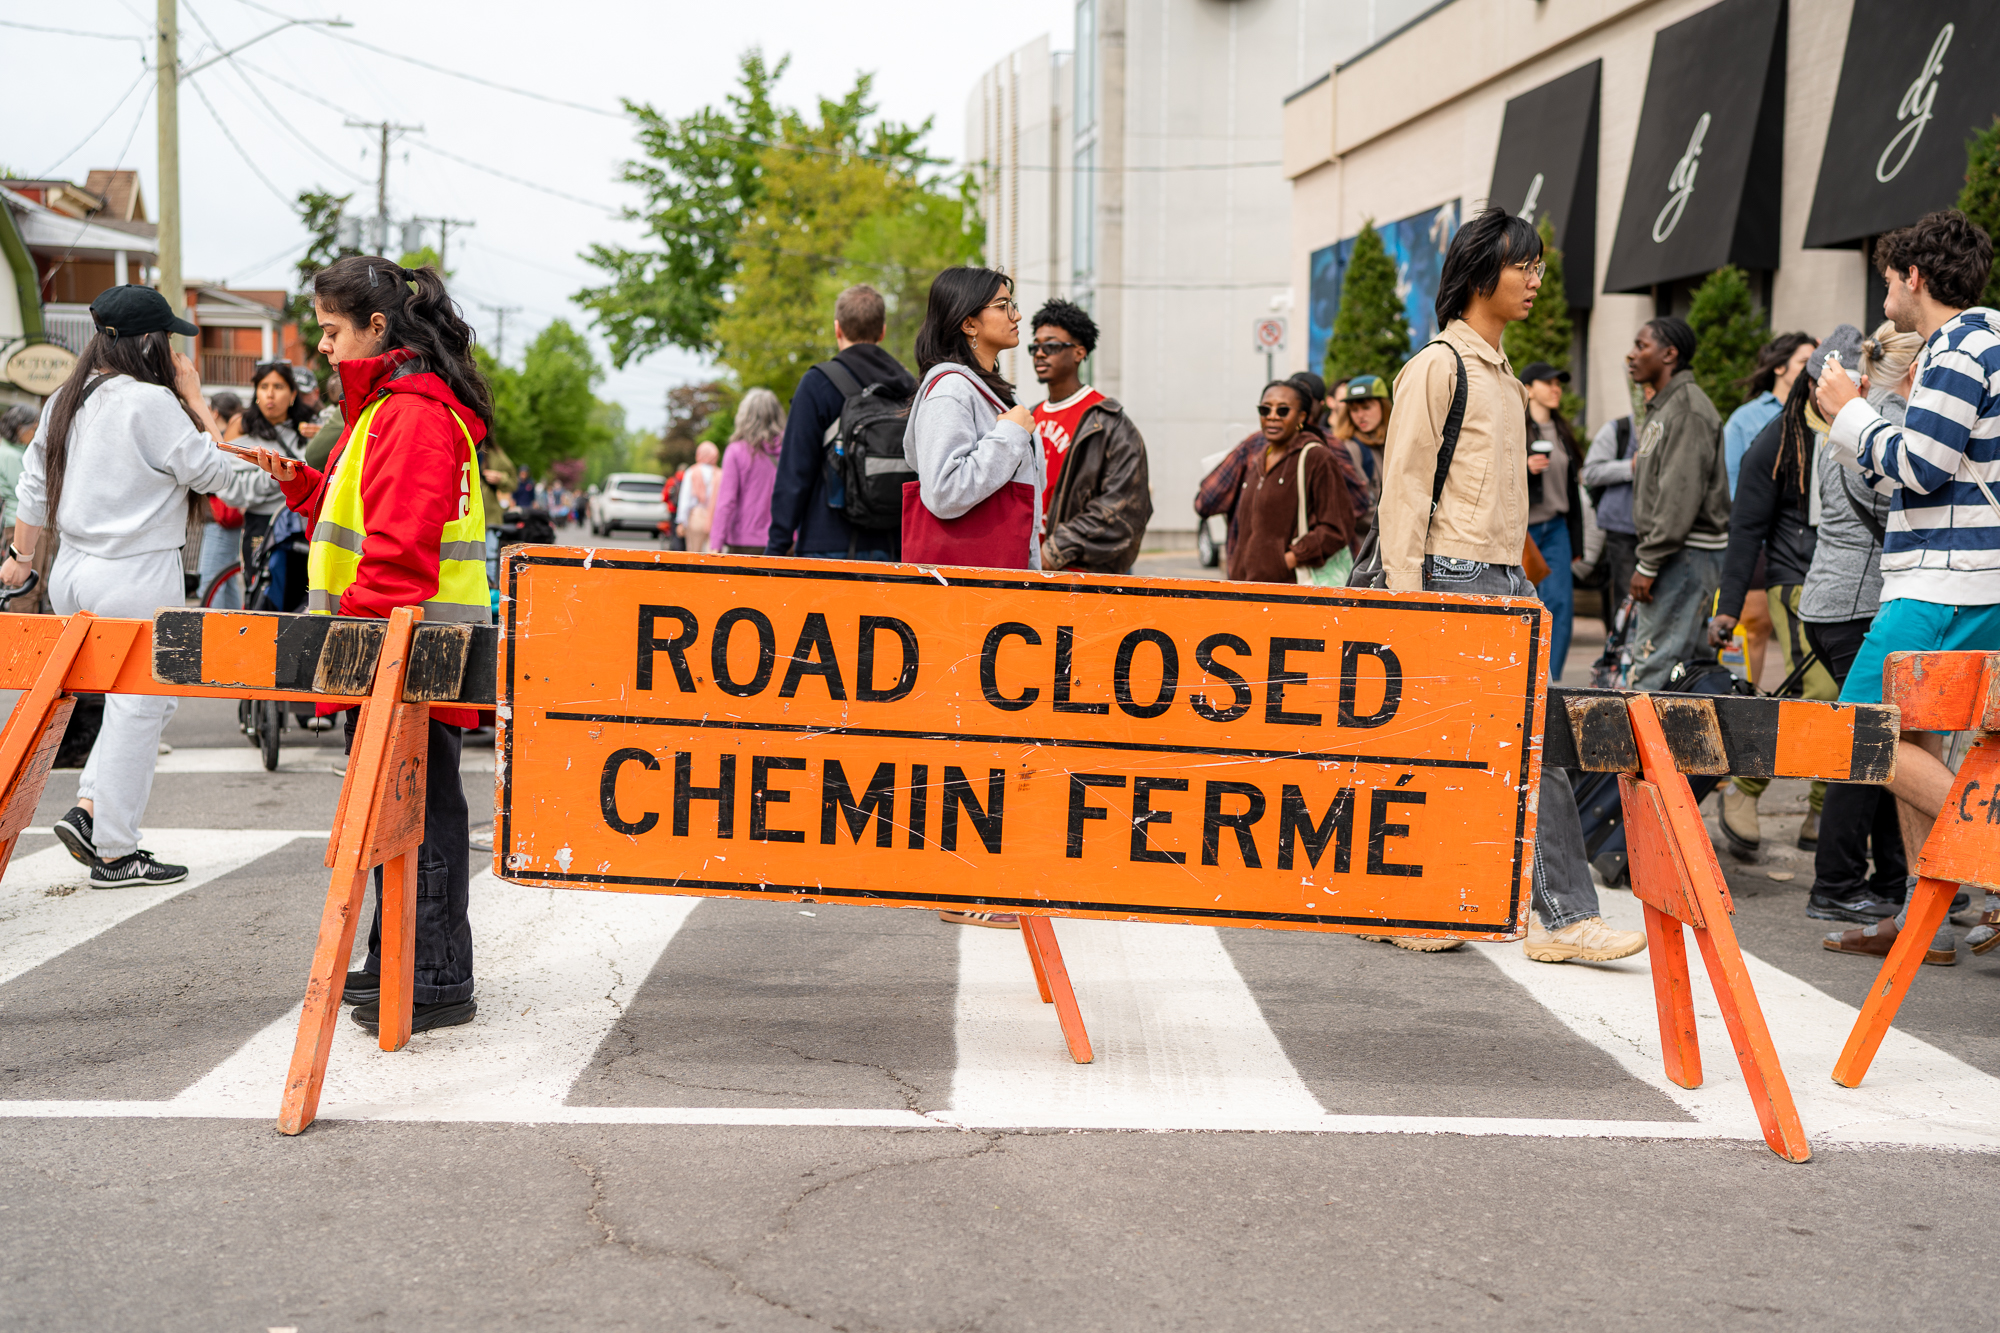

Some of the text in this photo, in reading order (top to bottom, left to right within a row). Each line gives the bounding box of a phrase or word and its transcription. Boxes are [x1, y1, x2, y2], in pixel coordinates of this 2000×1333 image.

[636, 603, 1402, 729] ROAD CLOSED
[599, 746, 1427, 878] CHEMIN FERMÉ
